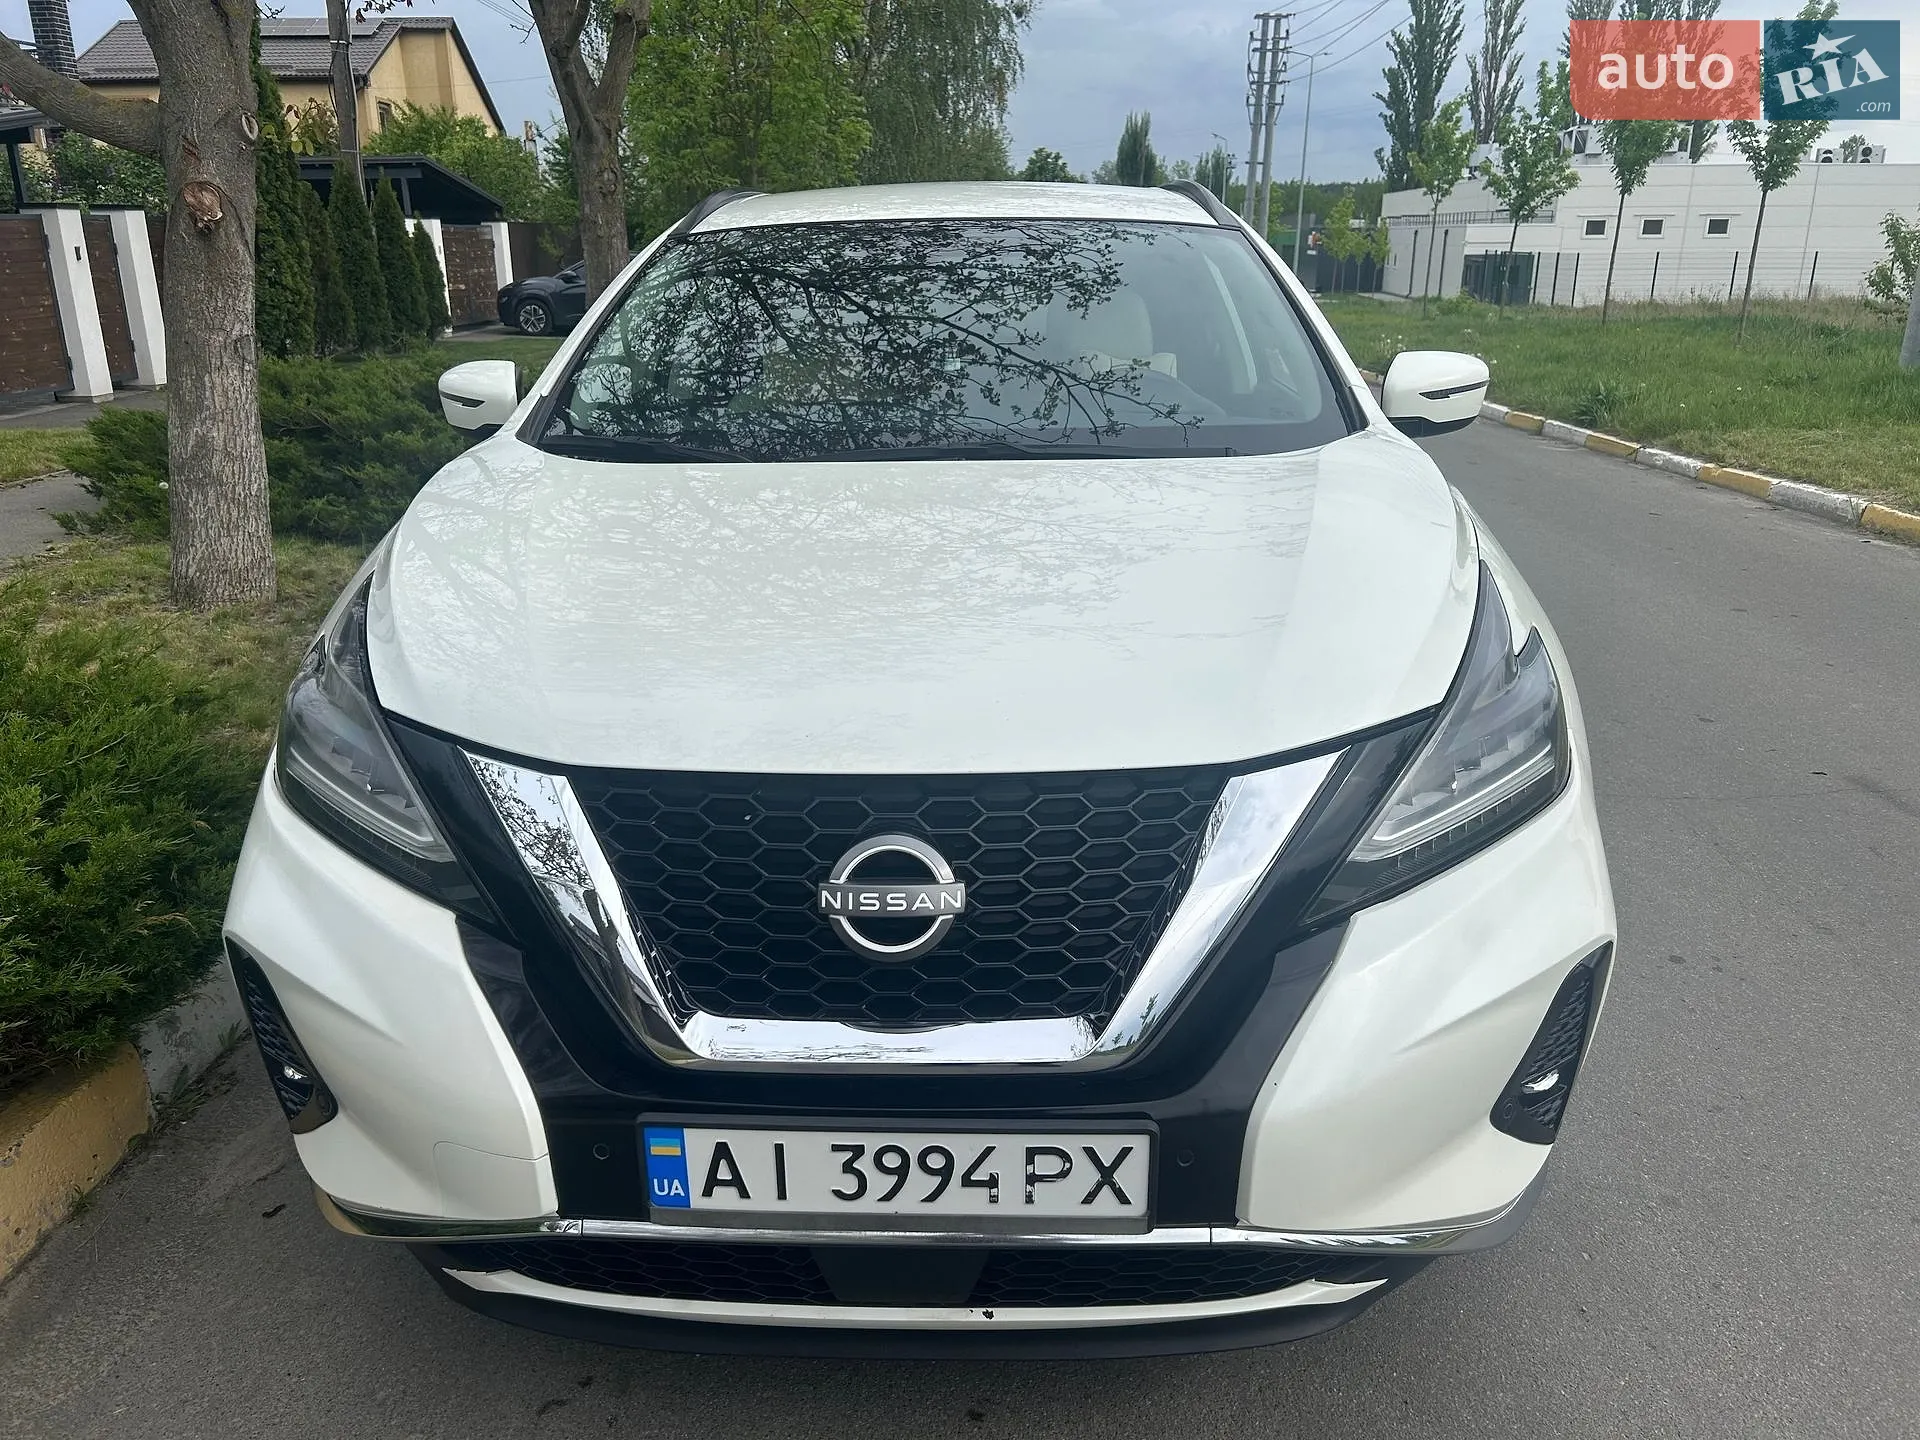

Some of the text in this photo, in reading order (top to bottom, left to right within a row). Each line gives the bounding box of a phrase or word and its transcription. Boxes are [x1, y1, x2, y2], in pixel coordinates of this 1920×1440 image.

[820, 889, 962, 911] NISSAN
[701, 1141, 1134, 1205] AI 3994 PX
[653, 1178, 686, 1197] UA
